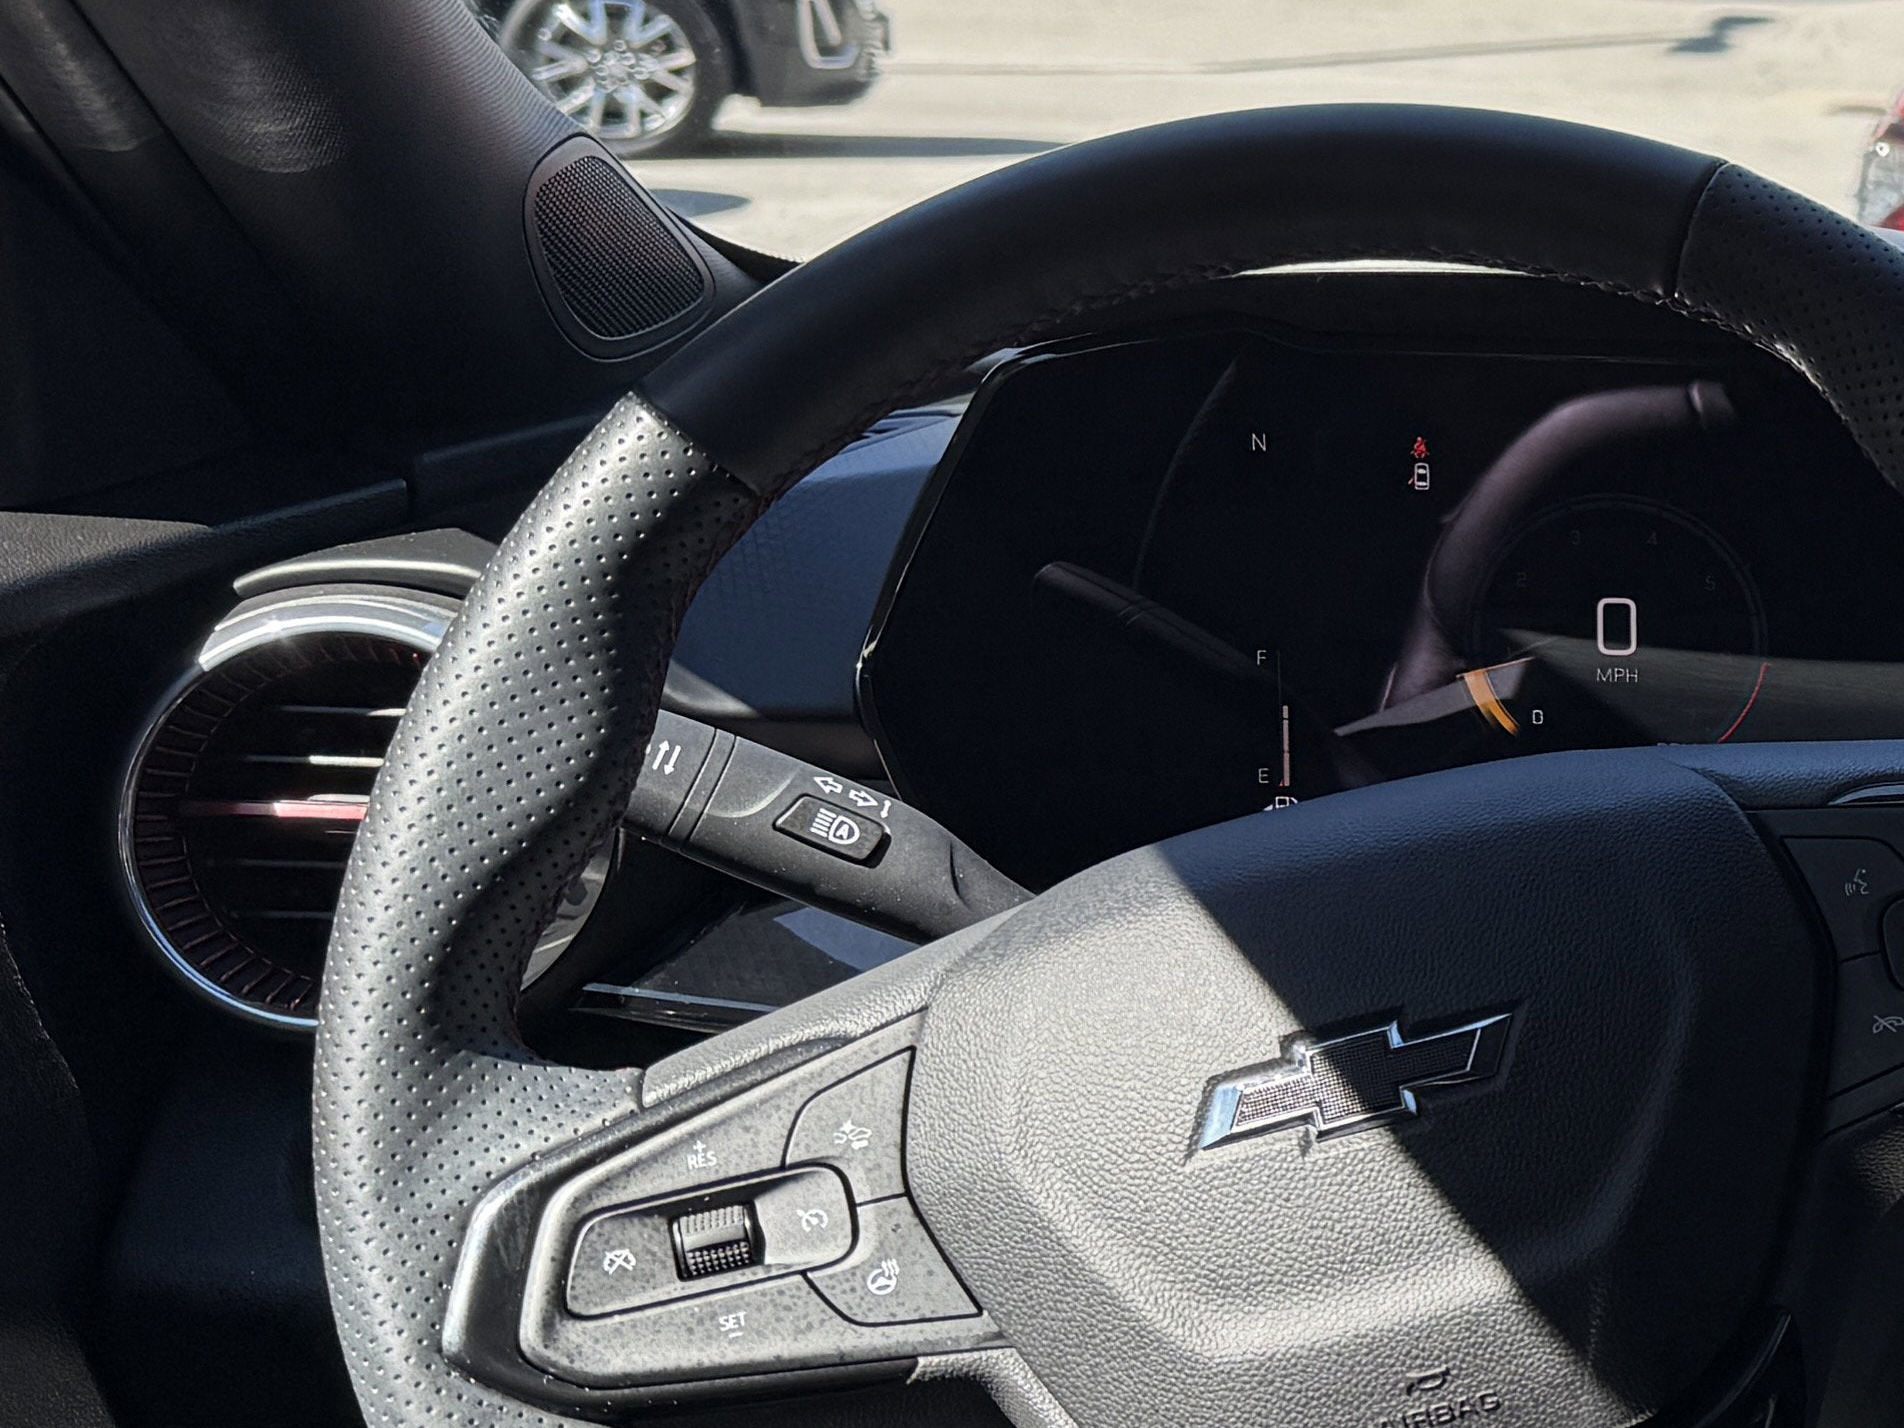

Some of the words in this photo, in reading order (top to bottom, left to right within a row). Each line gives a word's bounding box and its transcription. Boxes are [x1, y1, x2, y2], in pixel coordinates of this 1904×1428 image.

[1251, 433, 1266, 451] N
[1596, 597, 1637, 656] 0
[1256, 650, 1267, 666] F
[1596, 668, 1638, 683] MPH
[1258, 768, 1269, 784] E
[687, 1151, 718, 1171] RES
[718, 1311, 747, 1332] SET
